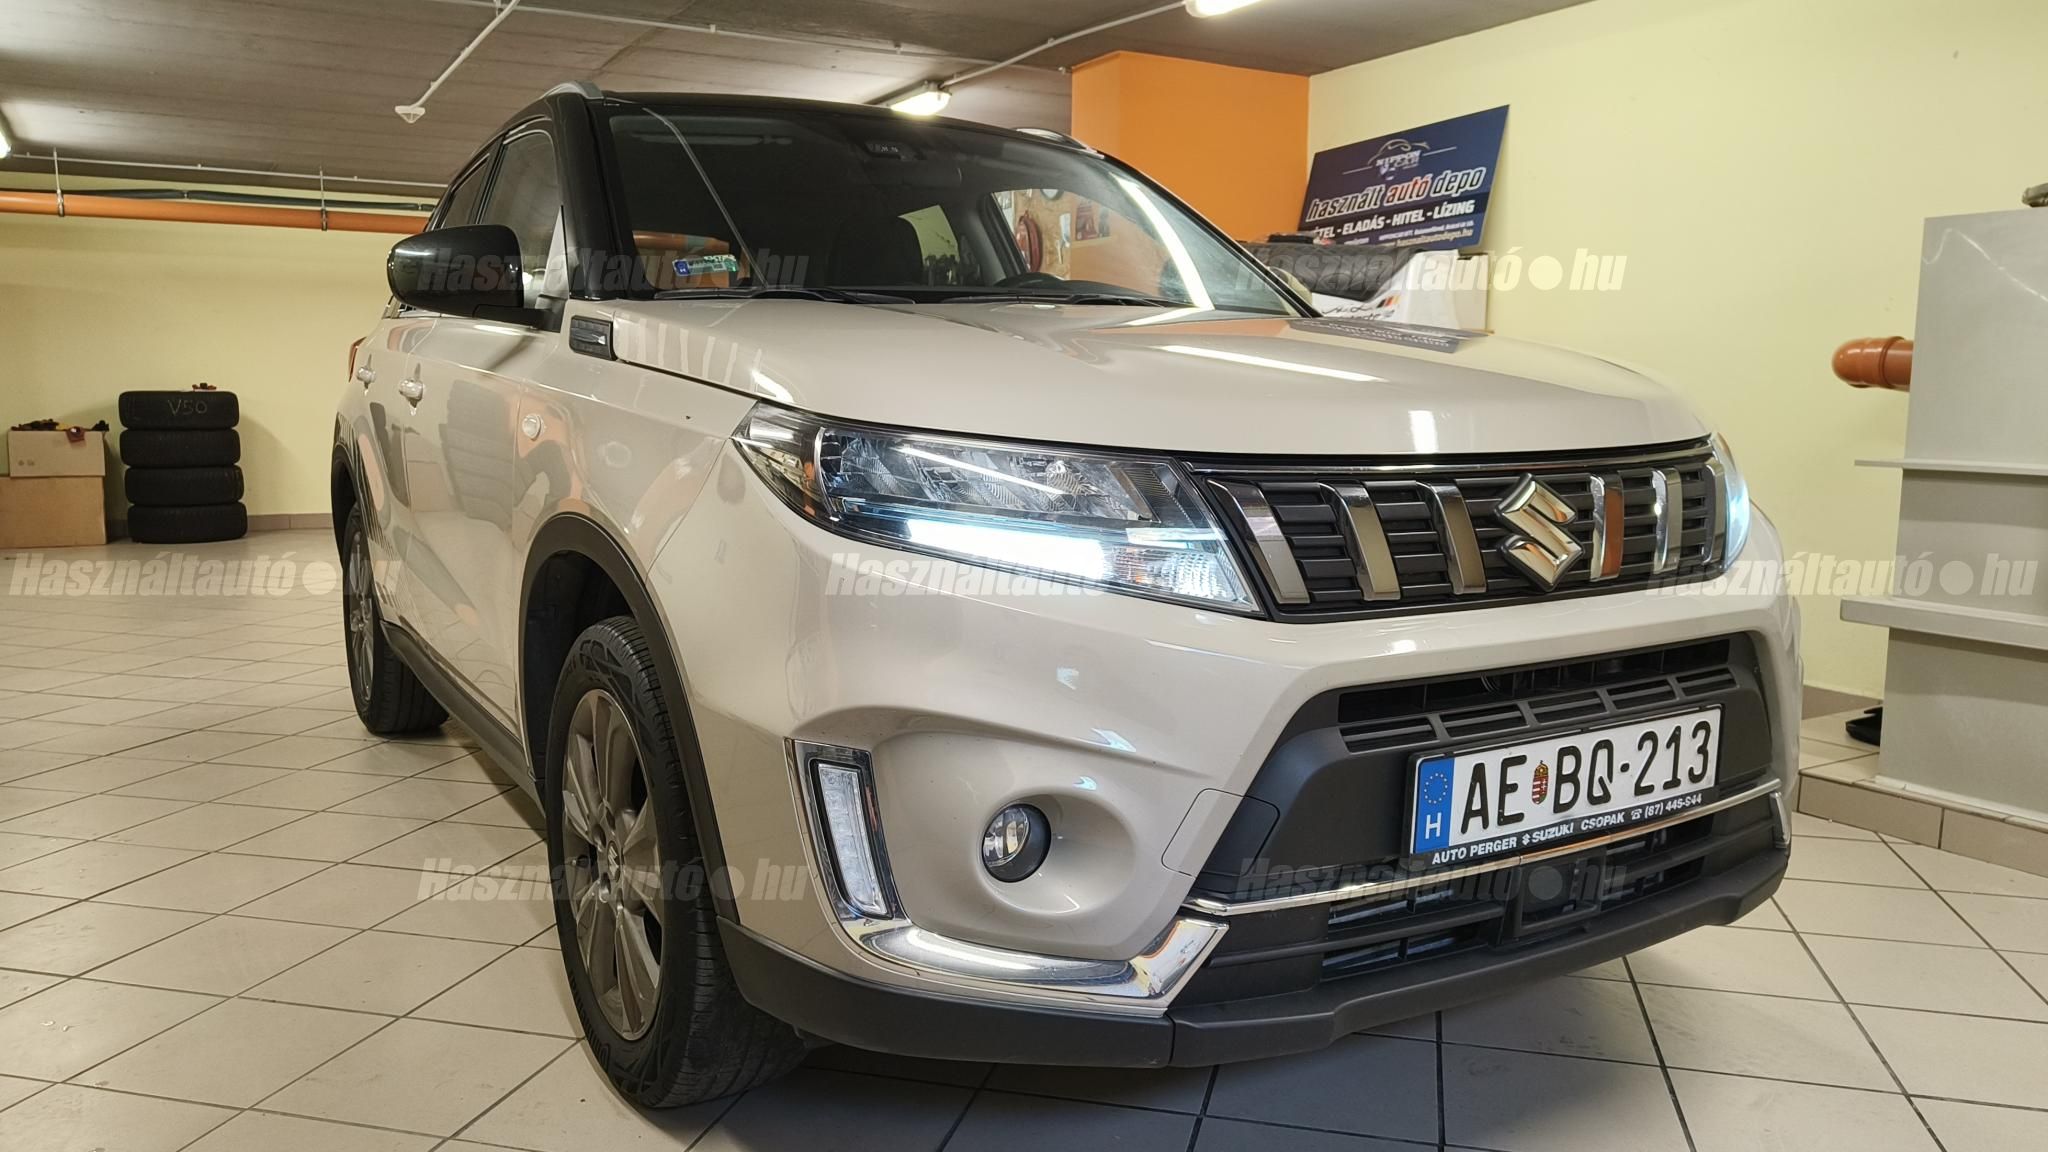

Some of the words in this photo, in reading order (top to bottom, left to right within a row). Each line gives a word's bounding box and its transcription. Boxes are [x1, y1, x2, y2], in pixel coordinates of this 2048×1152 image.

[1305, 184, 1385, 222] használt
[1384, 174, 1433, 206] autó
[1430, 167, 1486, 198] depo
[1342, 215, 1385, 235] ELADÁS
[1392, 209, 1425, 227] HITEL
[1433, 200, 1475, 219] LÍZING
[168, 399, 208, 416] V50
[1553, 720, 1712, 814] BQ-213
[1425, 812, 1442, 839] H
[1432, 847, 1467, 865] AUTO
[1470, 836, 1517, 857] PERGER
[1532, 822, 1574, 843] SUZUKI
[1581, 811, 1625, 831] CSOPAK
